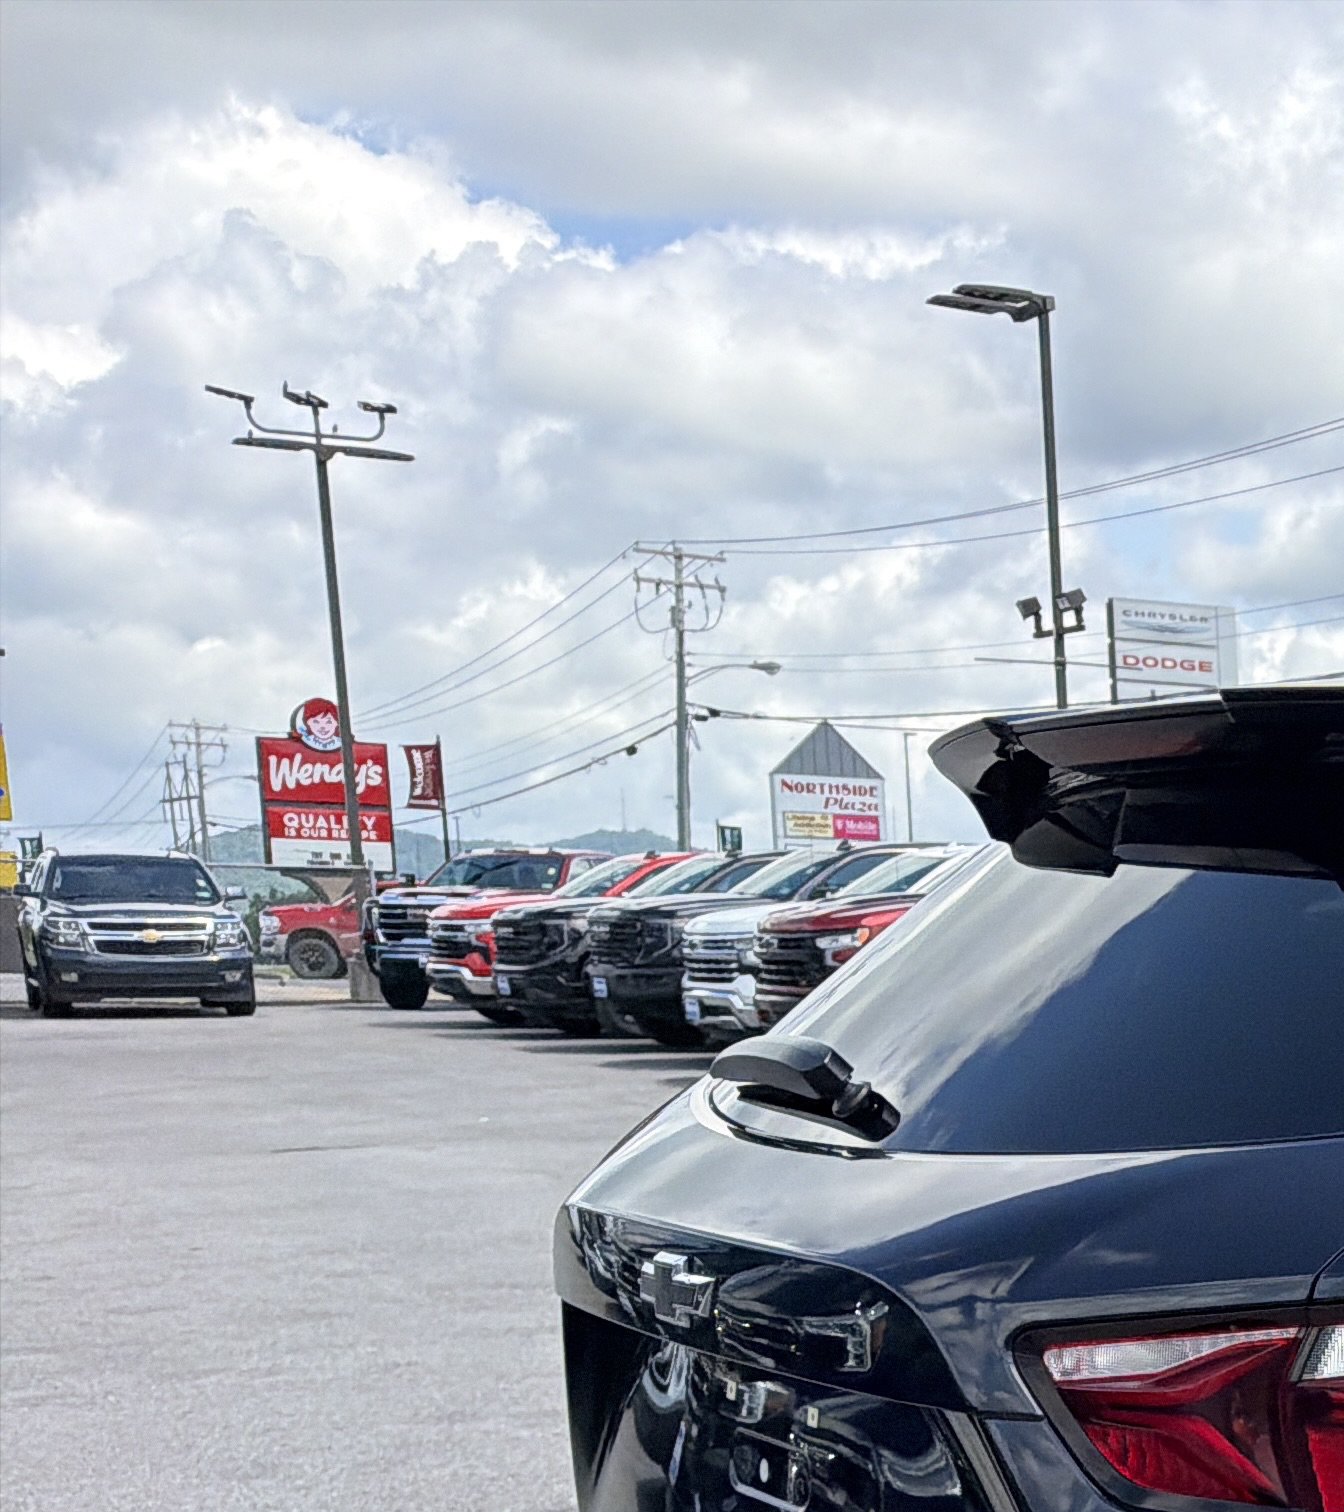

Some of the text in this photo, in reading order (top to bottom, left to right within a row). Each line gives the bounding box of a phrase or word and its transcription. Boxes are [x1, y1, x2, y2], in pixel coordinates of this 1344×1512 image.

[1122, 609, 1209, 623] CHRYSLER
[1122, 655, 1213, 672] DODGE
[780, 779, 878, 797] NORTHSIDE
[823, 796, 879, 812] Plaza
[282, 812, 376, 830] QUALIY
[284, 827, 378, 840] IS OUR REPE
